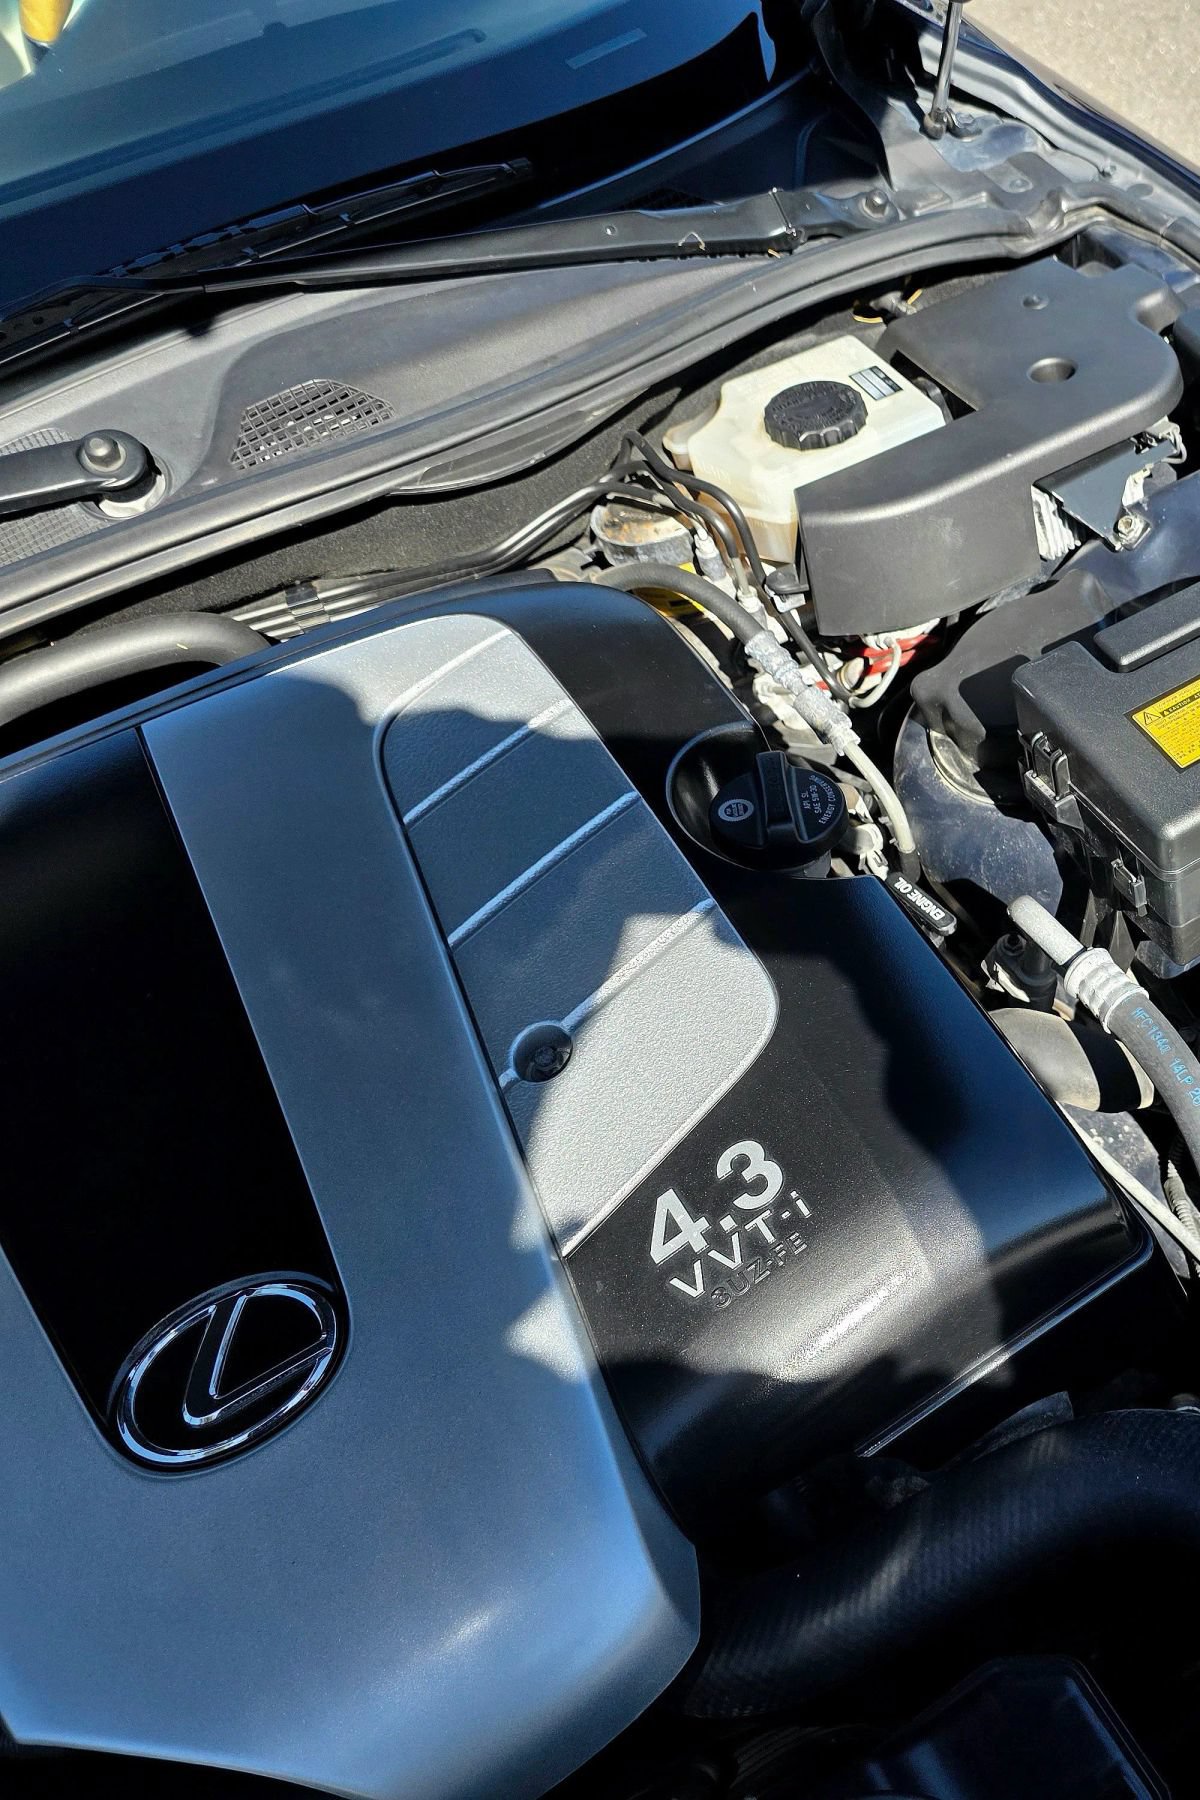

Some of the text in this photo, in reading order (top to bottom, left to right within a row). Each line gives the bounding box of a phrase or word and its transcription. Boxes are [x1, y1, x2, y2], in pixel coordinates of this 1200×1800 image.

[1167, 697, 1192, 712] CAUTION
[809, 774, 836, 824] ENERGY CONSERVING
[810, 785, 821, 814] SAE 5W-30
[893, 876, 946, 921] ENGINE OIL
[650, 1140, 783, 1265] 4.3
[669, 1190, 812, 1298] VVT-i
[710, 1232, 808, 1309] 3UZ-FE
